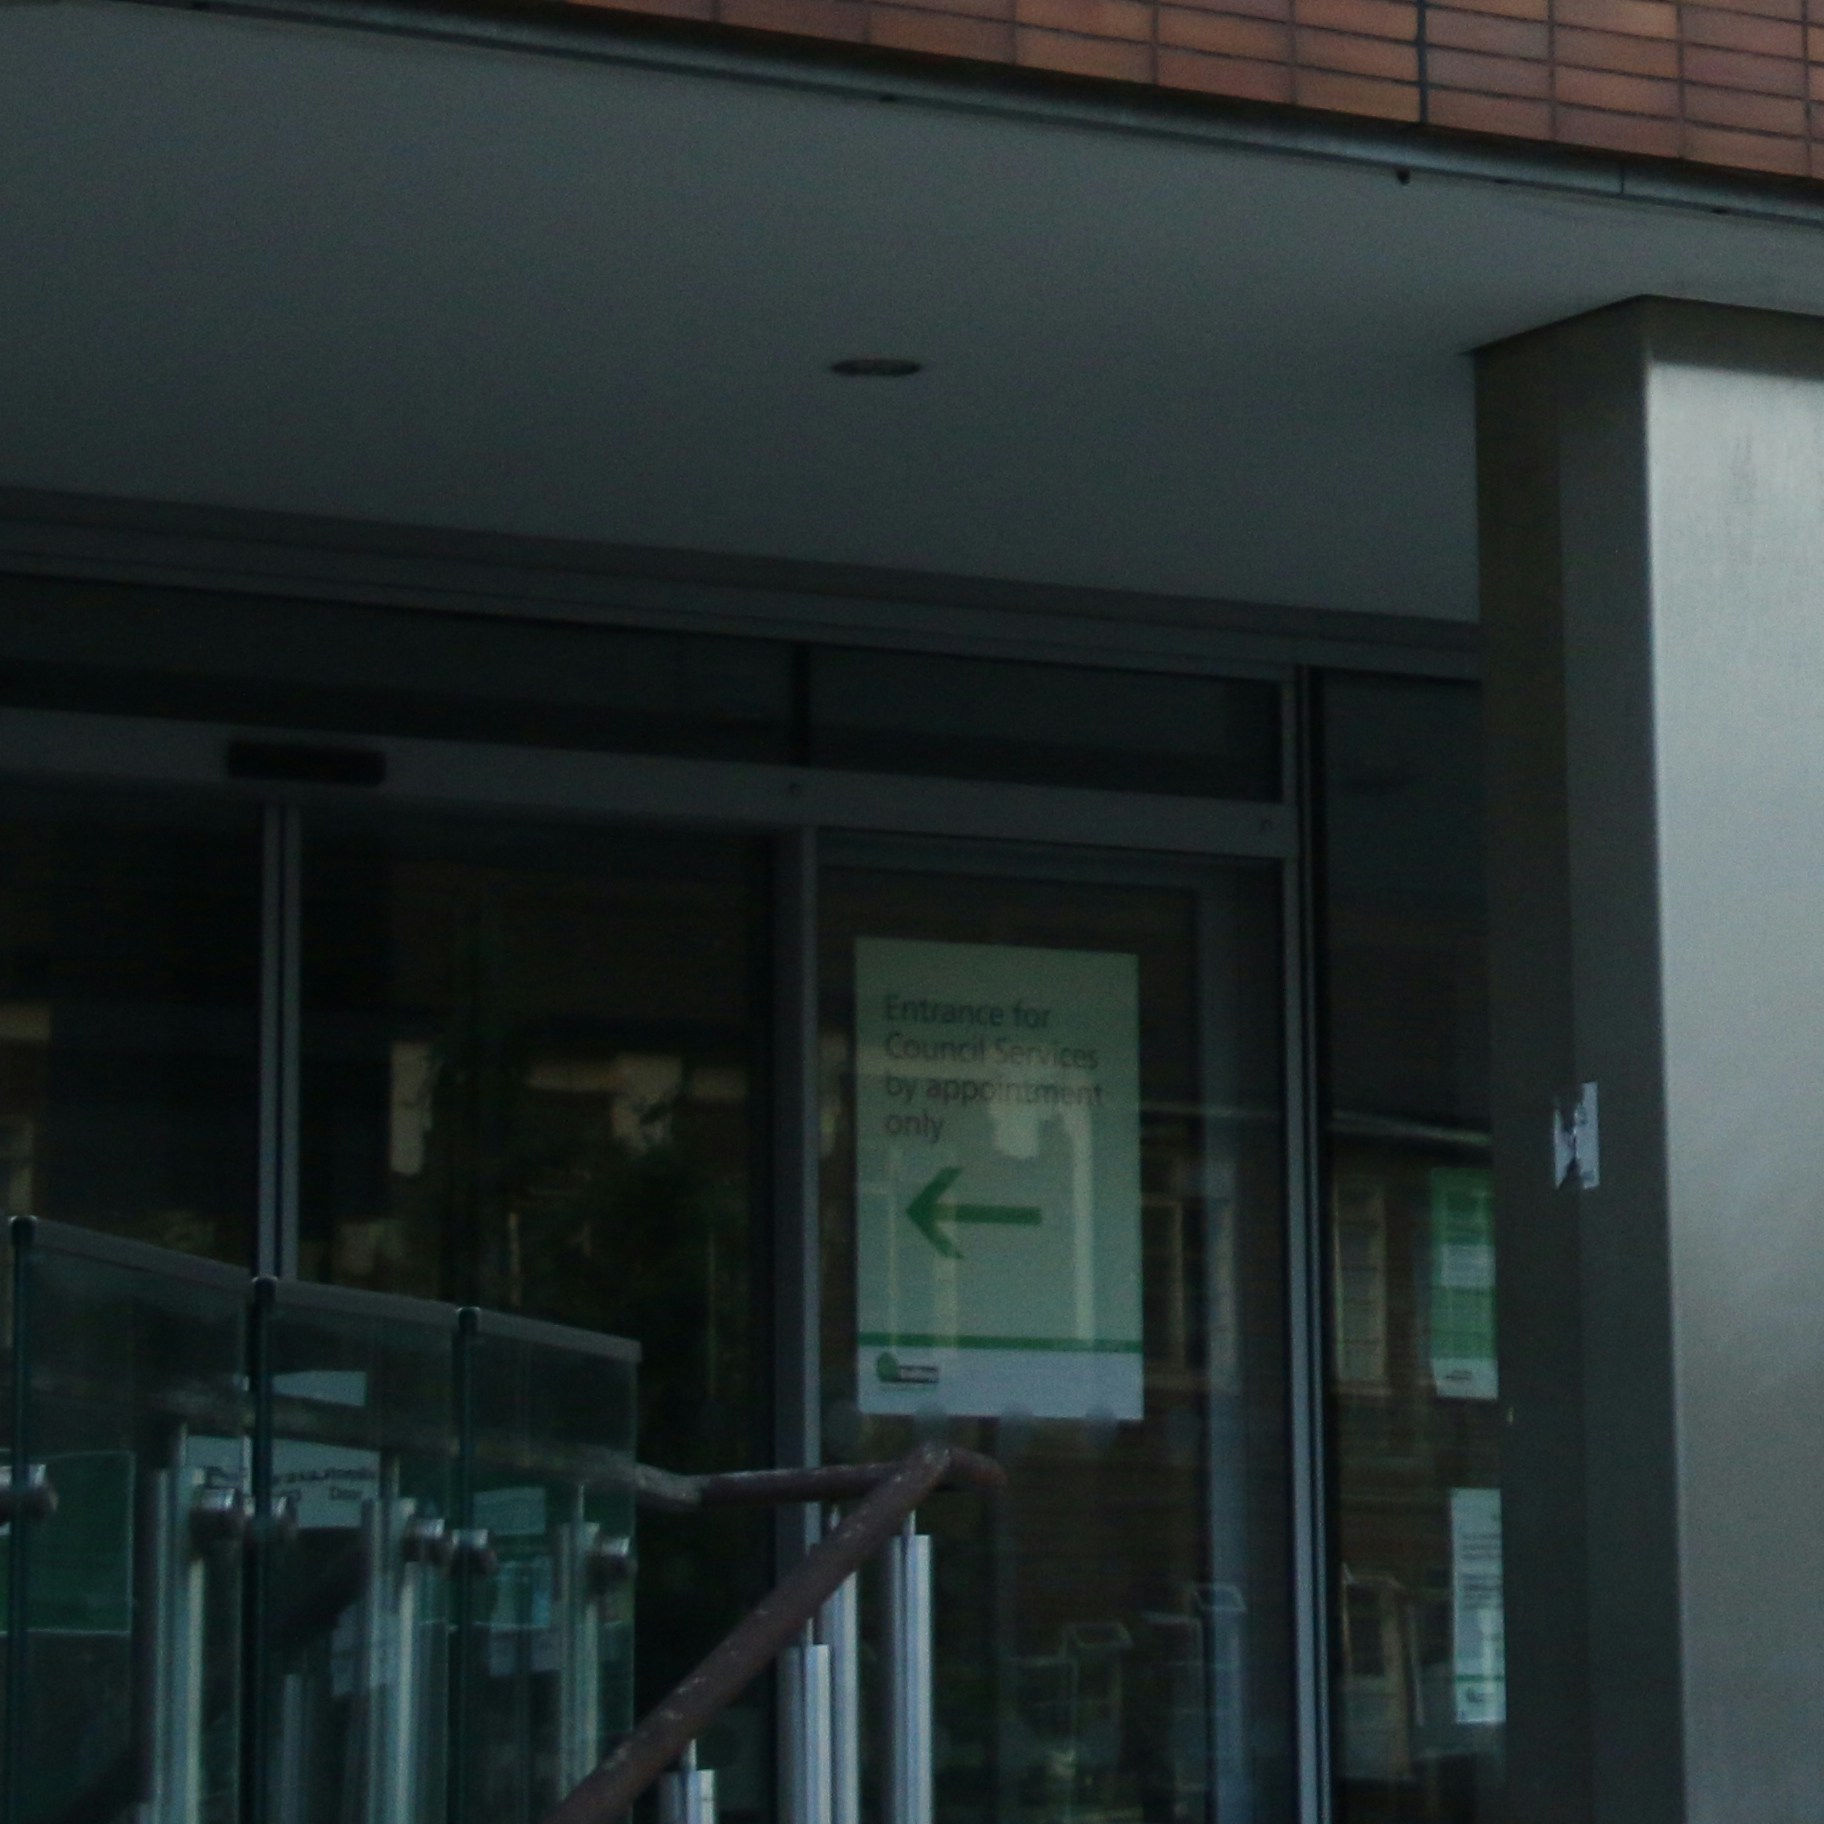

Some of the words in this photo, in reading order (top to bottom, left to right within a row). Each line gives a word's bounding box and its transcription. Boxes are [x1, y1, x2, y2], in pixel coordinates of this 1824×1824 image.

[885, 994, 1003, 1026] Entrance
[1013, 999, 1051, 1028] for
[885, 1032, 985, 1062] Council
[994, 1038, 1098, 1069] Services
[885, 1072, 917, 1103] by
[926, 1079, 1102, 1108] appointment
[885, 1112, 943, 1143] only
